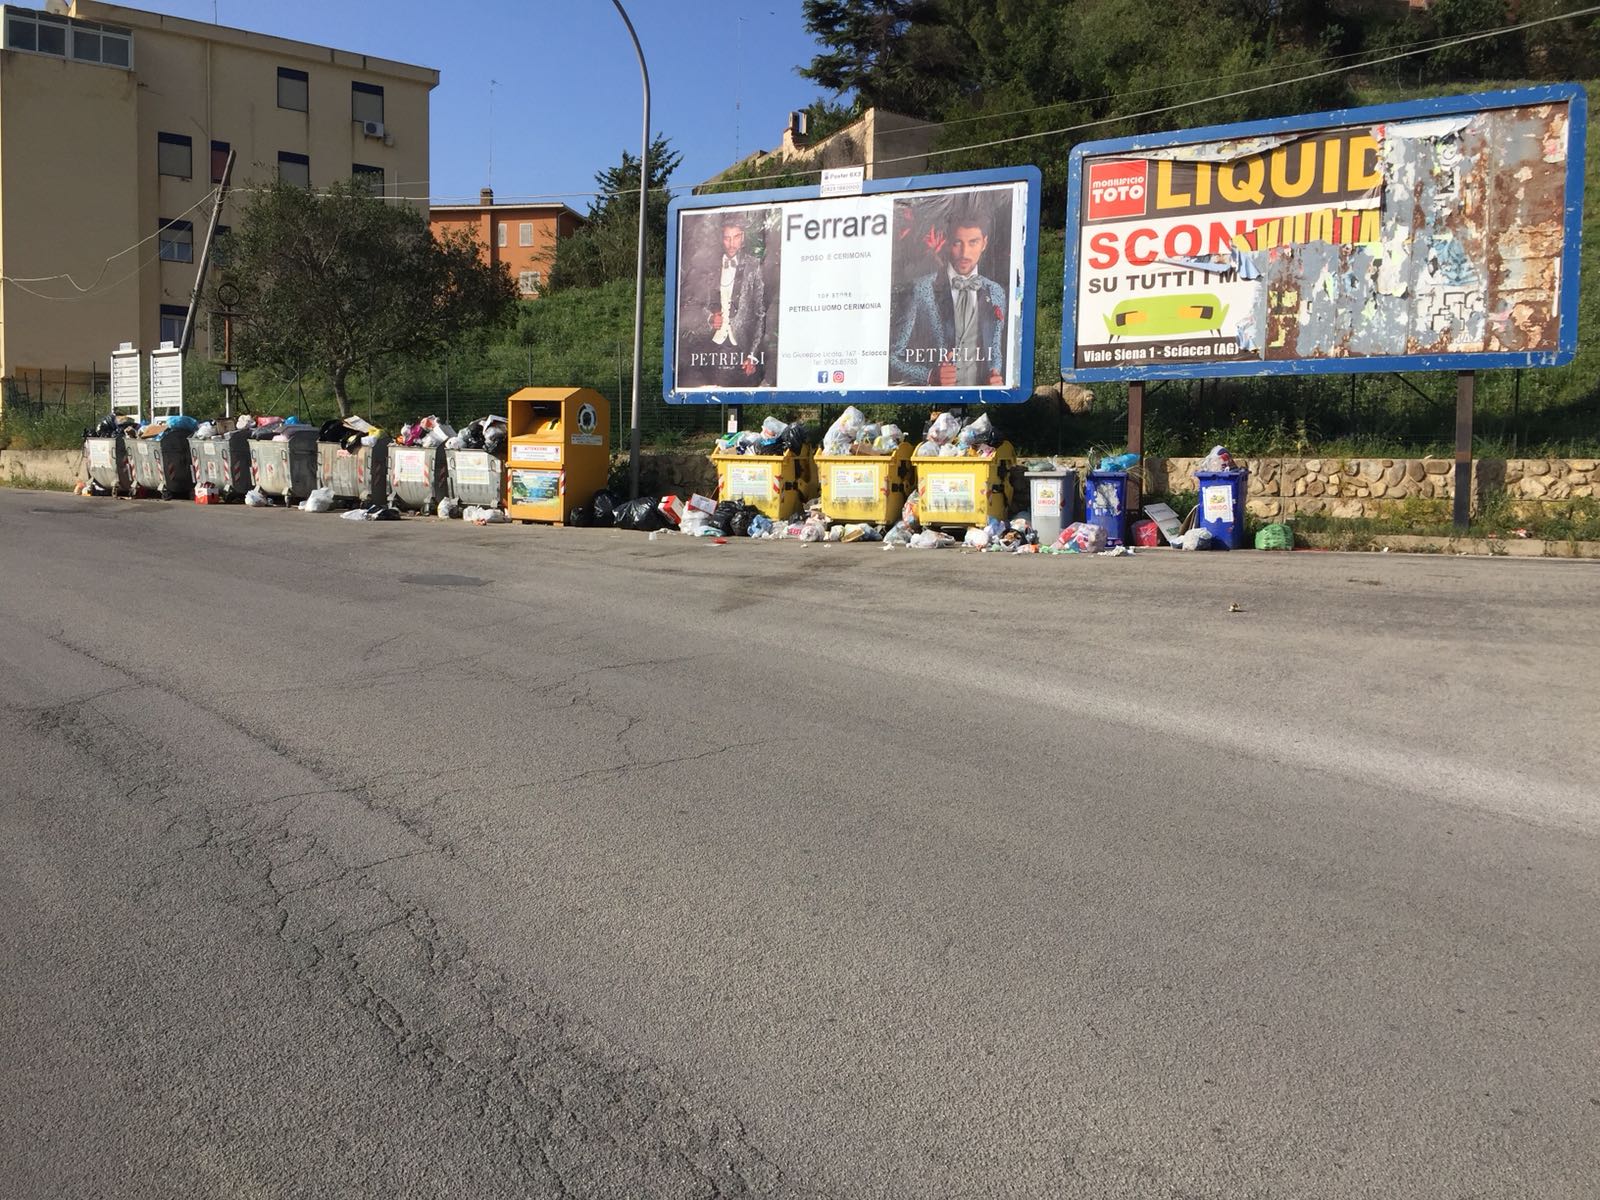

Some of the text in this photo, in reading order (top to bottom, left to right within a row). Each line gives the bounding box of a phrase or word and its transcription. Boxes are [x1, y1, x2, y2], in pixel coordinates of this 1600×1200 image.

[1092, 185, 1144, 204] TOTO
[787, 213, 887, 241] Ferrara
[800, 254, 824, 262] SPOSO
[833, 252, 872, 260] CERIMONIA
[1088, 276, 1118, 294] SU
[1126, 271, 1194, 291] TUTTI
[843, 302, 881, 310] CERIMONIA
[905, 347, 993, 362] PETRELLI
[1083, 350, 1112, 362] Viale
[1114, 348, 1146, 360] Siena
[1149, 348, 1155, 358] 1
[1164, 344, 1211, 358] Sciacca
[1213, 342, 1239, 355] (AG)
